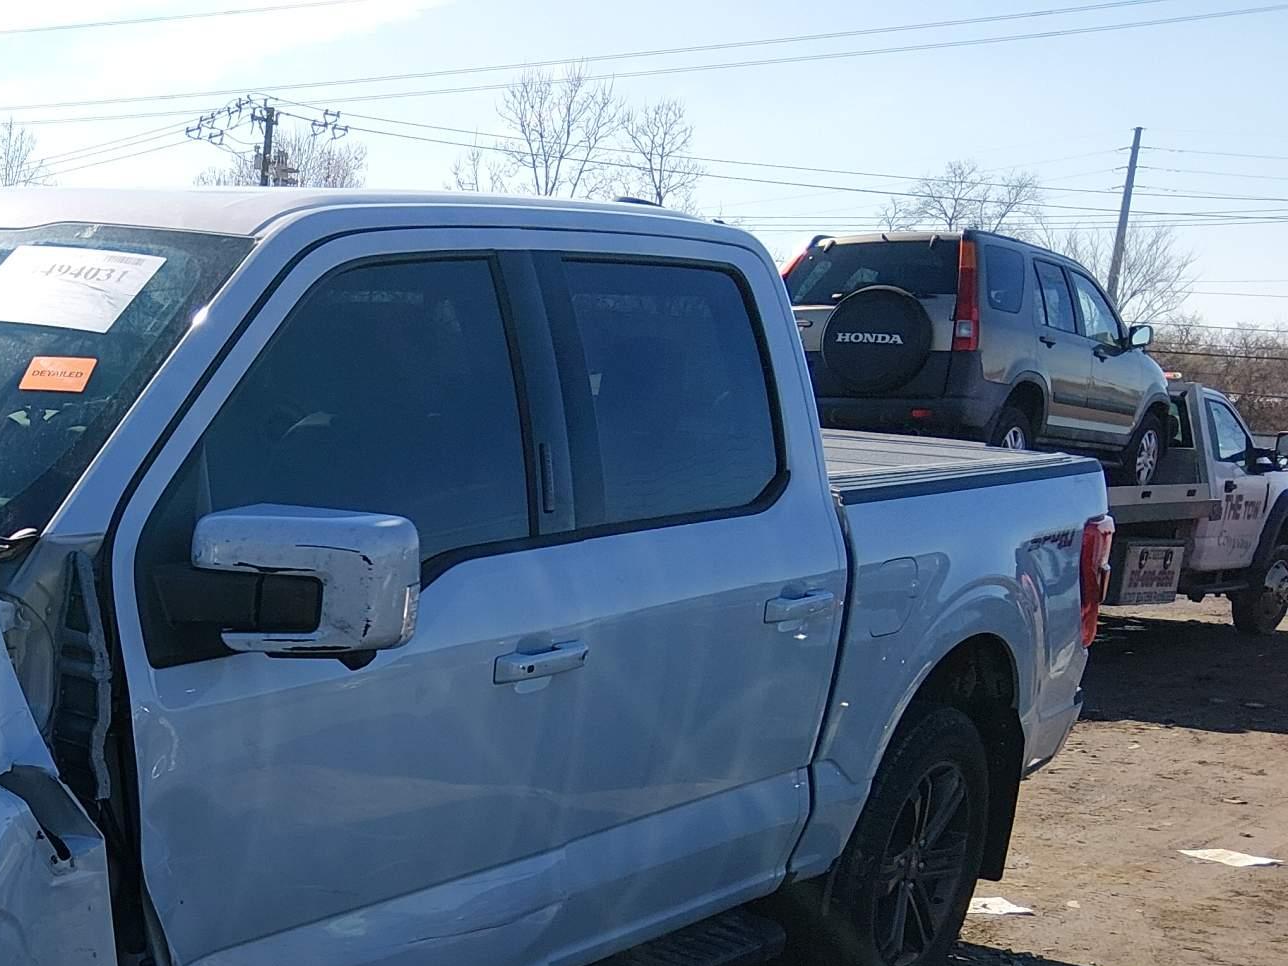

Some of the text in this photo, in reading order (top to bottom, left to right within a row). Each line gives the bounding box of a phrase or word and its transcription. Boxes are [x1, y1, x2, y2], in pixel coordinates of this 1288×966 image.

[835, 332, 904, 345] HONDA
[31, 369, 85, 379] DETAILED
[1223, 494, 1244, 521] THE
